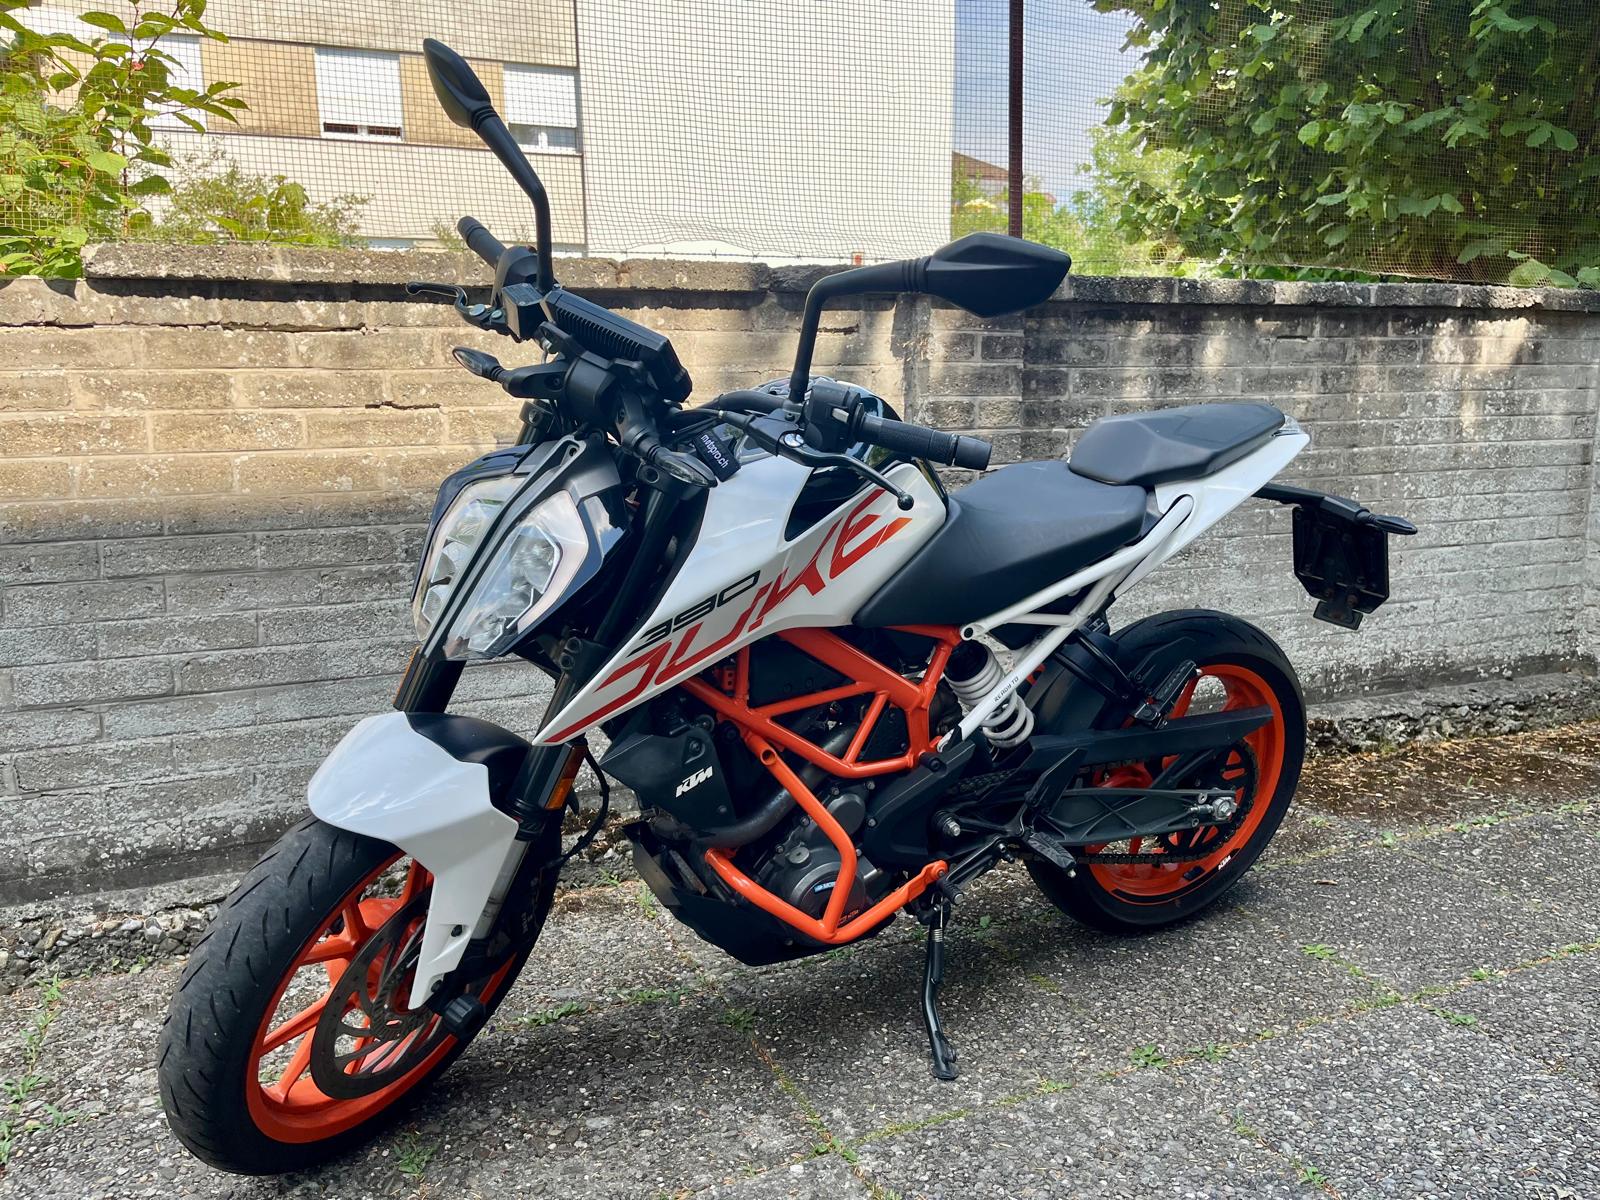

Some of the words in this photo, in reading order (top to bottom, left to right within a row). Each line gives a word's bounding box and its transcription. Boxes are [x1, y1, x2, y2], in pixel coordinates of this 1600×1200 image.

[544, 488, 913, 743] DUKE
[625, 570, 761, 658] 390
[675, 765, 713, 798] KTM
